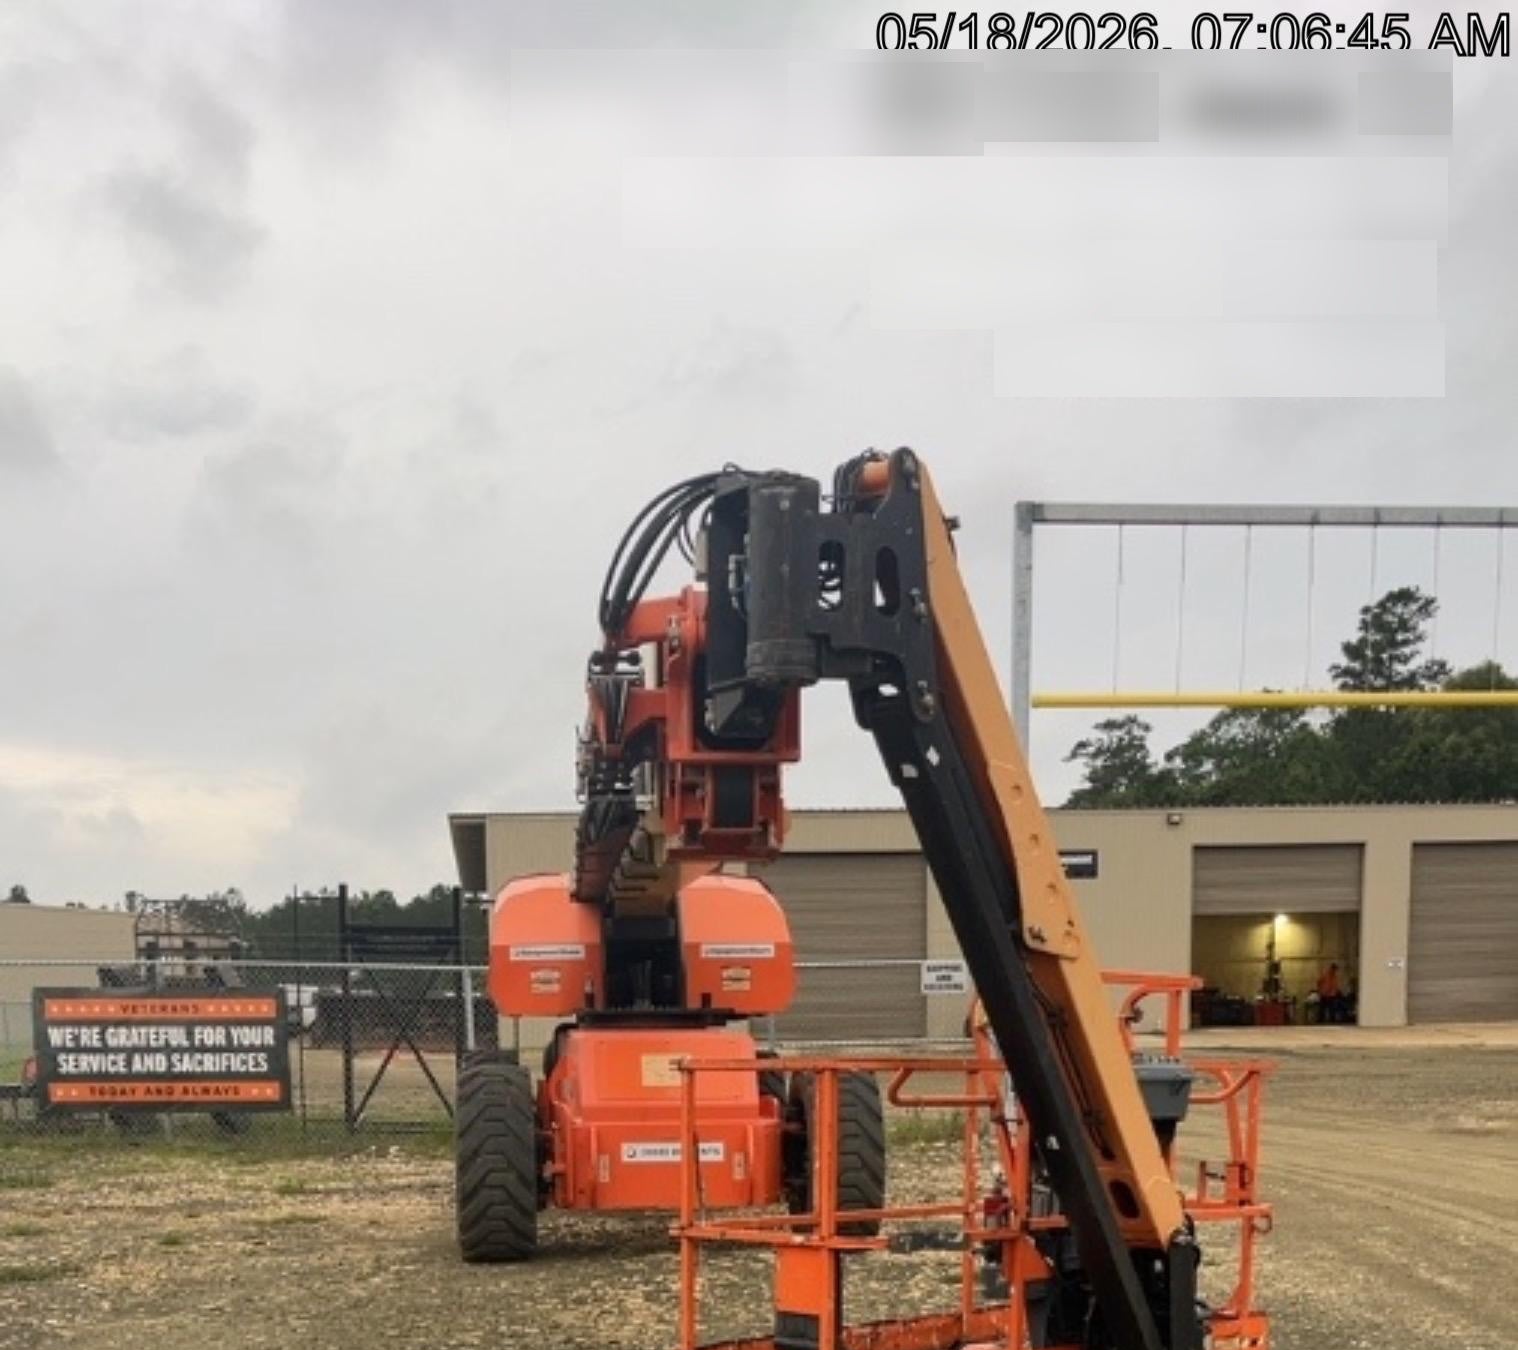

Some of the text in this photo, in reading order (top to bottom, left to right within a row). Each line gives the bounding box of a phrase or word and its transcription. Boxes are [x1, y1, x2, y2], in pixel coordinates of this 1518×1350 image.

[120, 1003, 200, 1015] VETERANS
[47, 1024, 275, 1048] WE'RE GRATEFUL FOR YOUR
[56, 1052, 268, 1074] SERVICE AND SACRIFICES
[89, 1085, 241, 1097] TODAY AND ALWAYS
